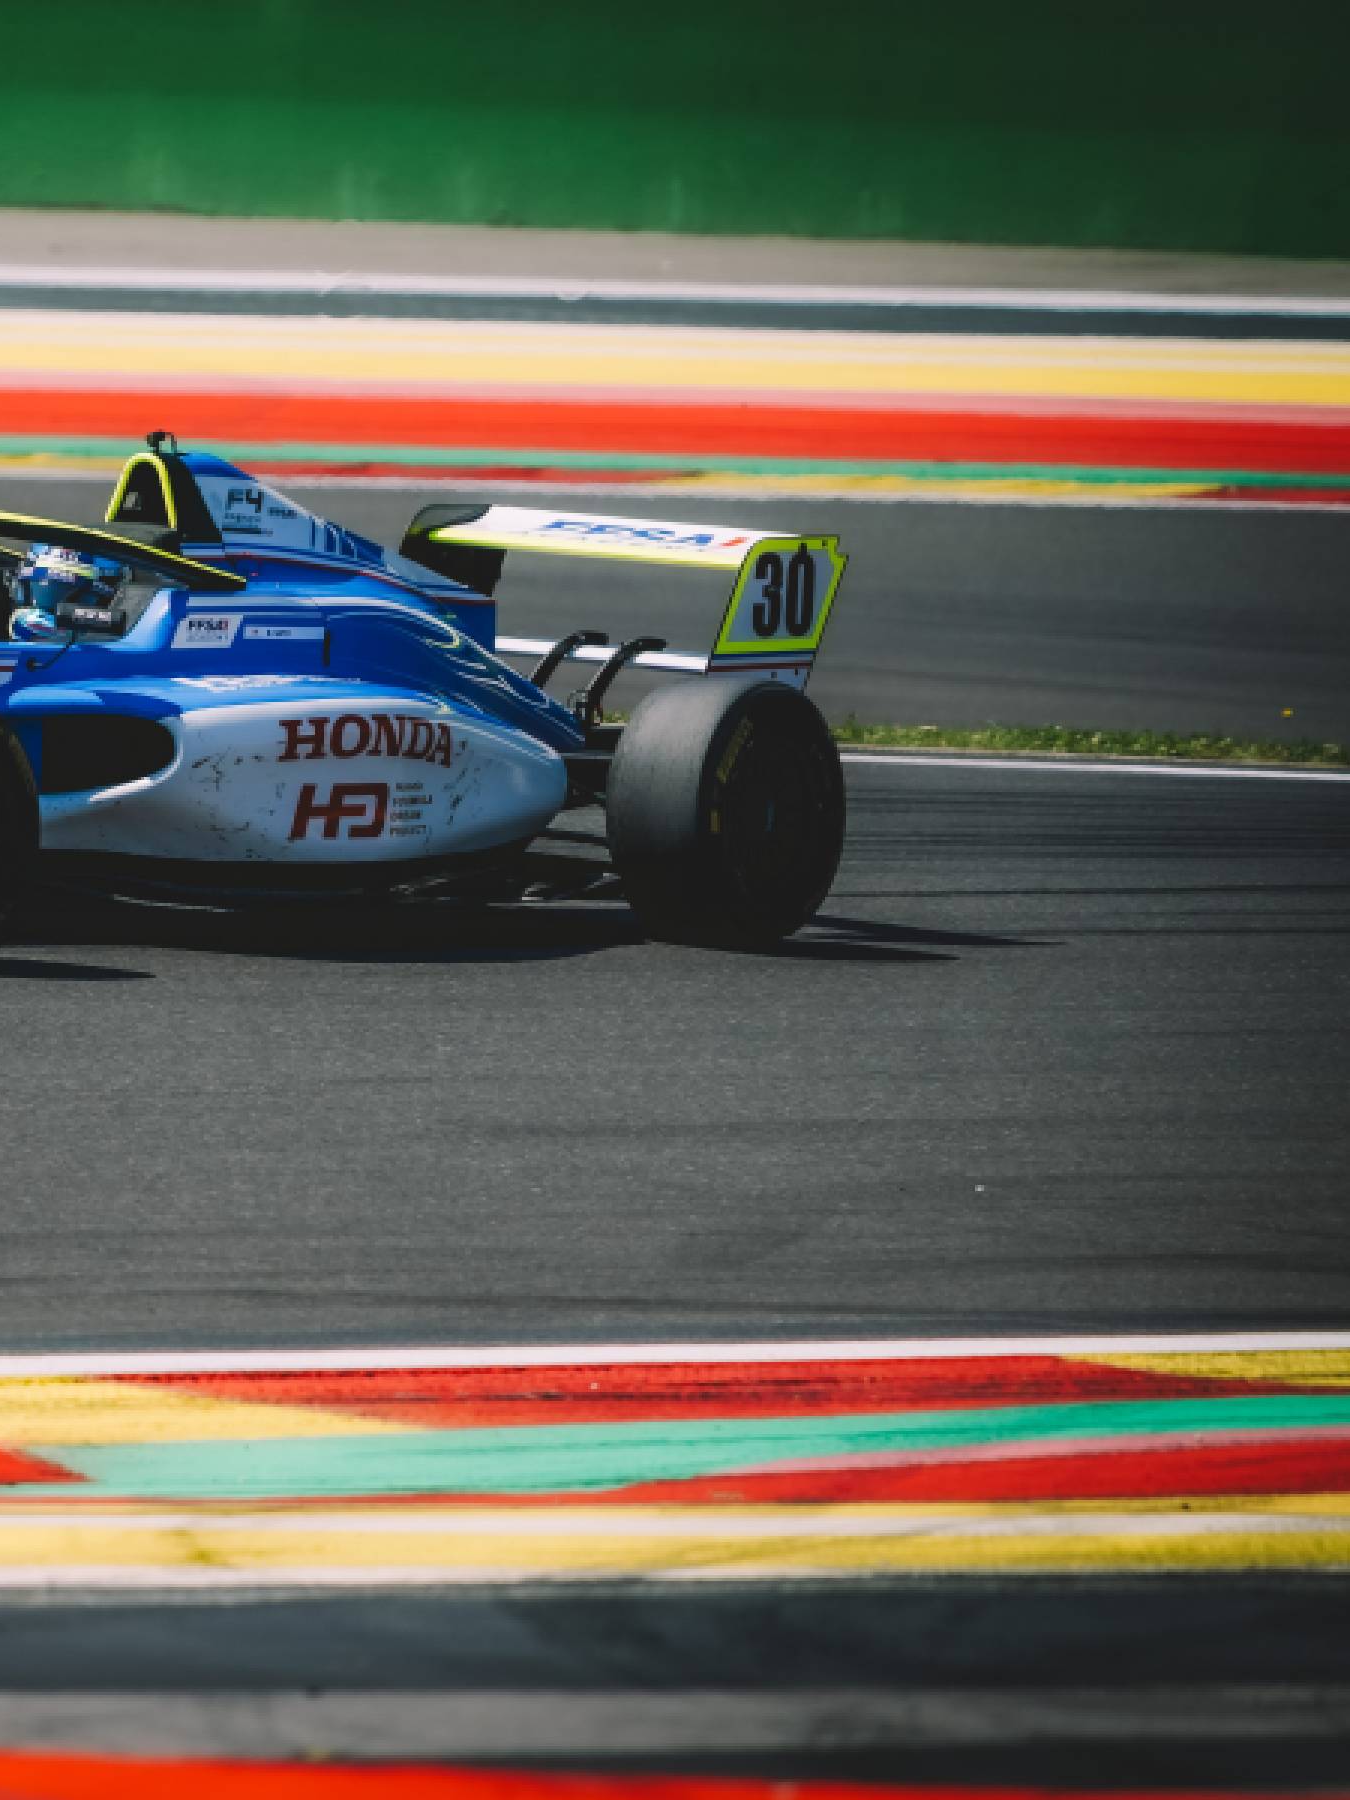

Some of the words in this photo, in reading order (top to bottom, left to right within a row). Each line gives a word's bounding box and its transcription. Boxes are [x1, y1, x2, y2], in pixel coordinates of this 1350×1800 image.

[227, 488, 264, 513] F4
[542, 521, 712, 544] FFSA
[752, 550, 814, 638] 30
[277, 714, 451, 768] HONDA
